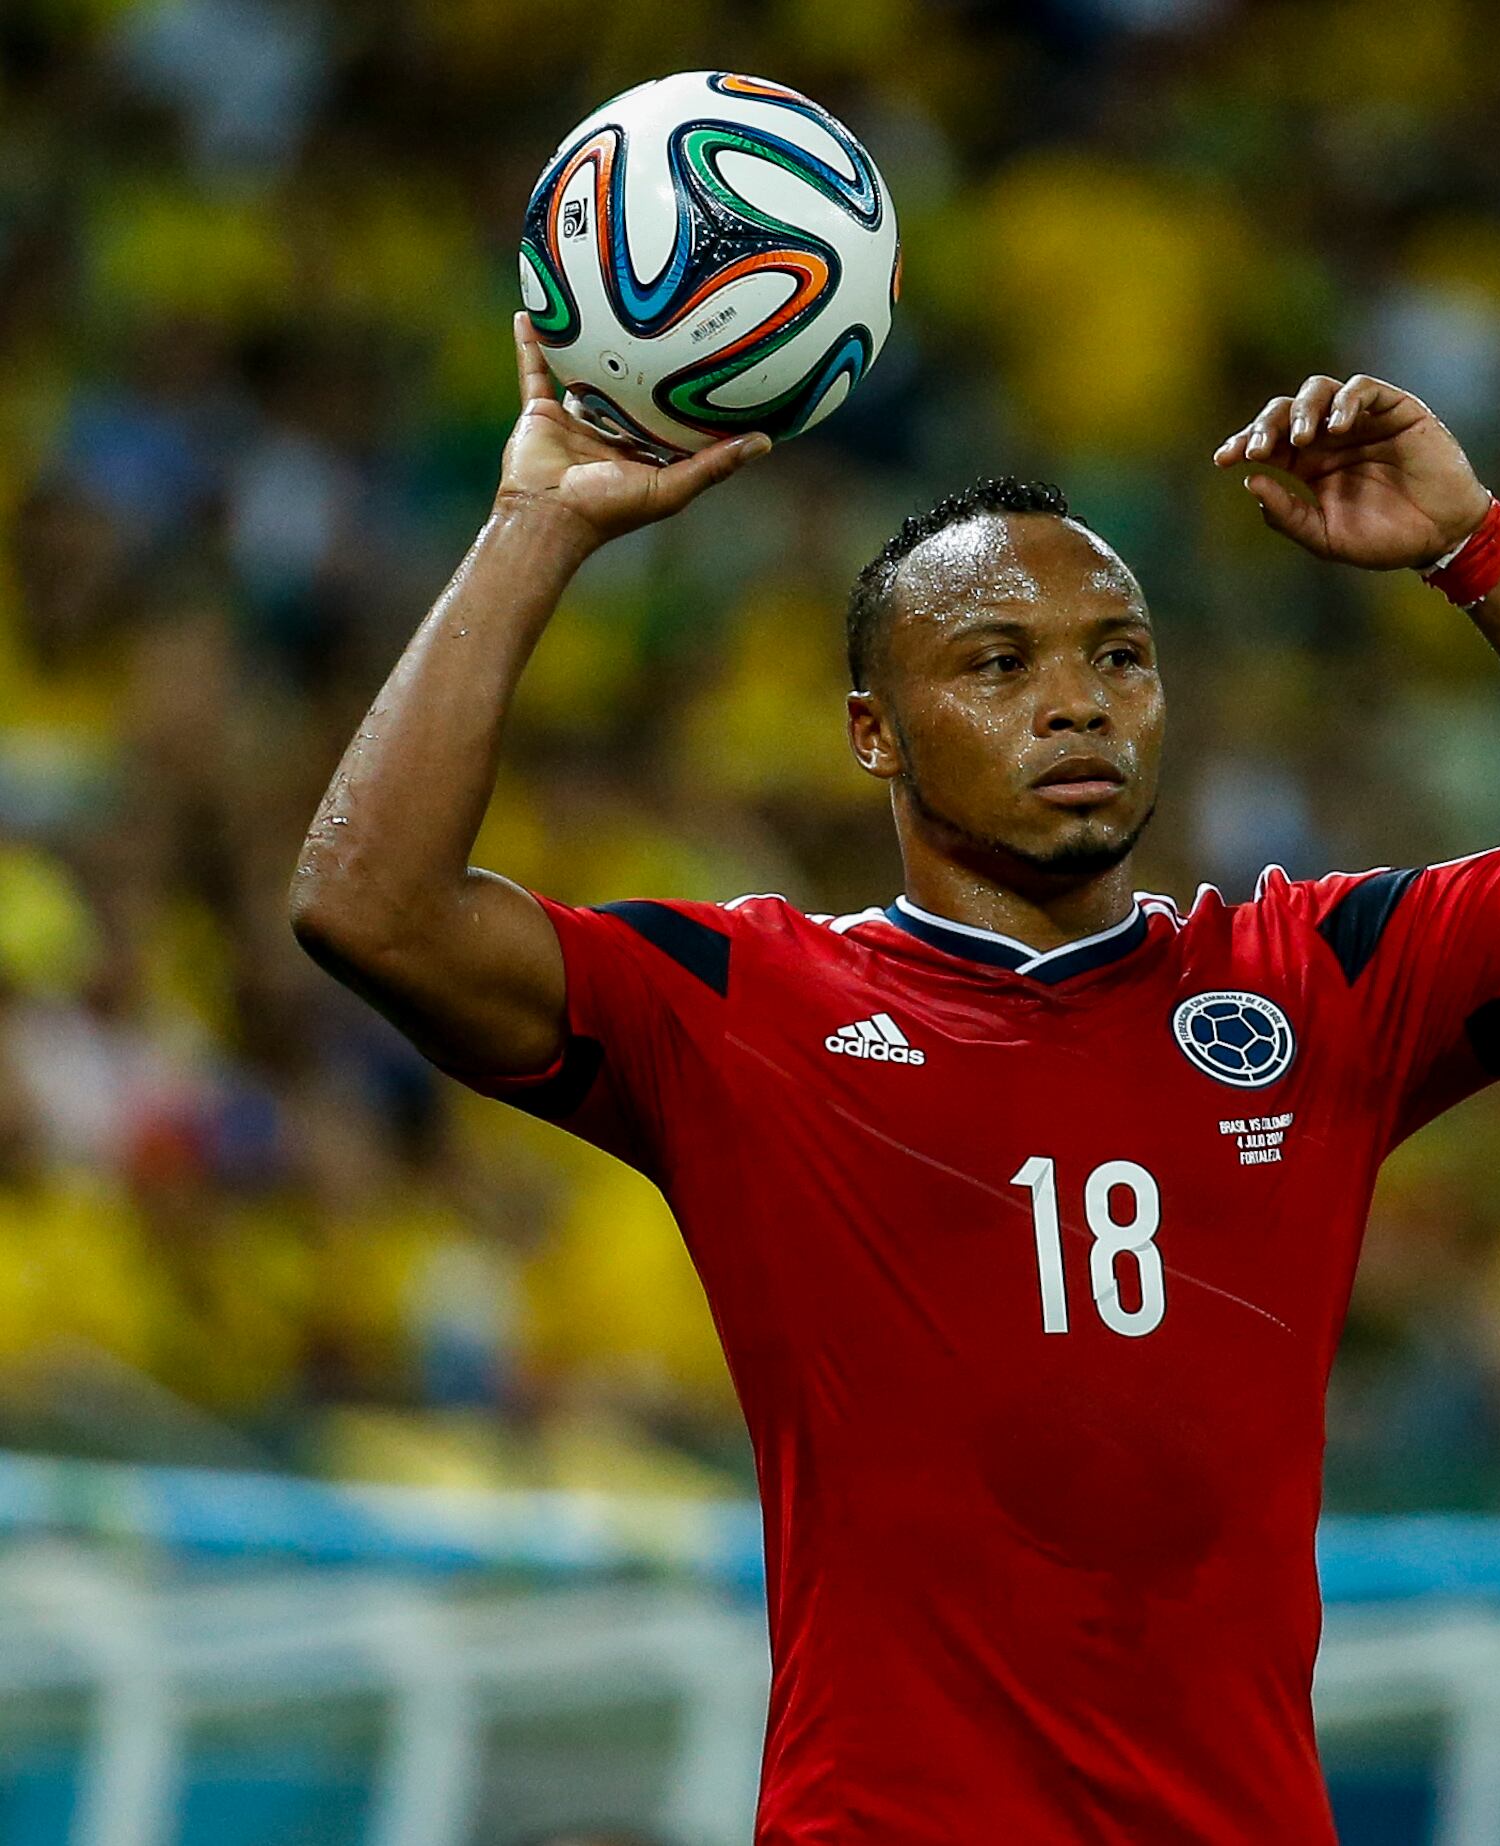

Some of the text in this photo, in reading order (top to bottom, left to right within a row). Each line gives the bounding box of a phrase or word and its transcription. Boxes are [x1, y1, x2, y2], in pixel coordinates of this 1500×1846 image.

[825, 1035, 925, 1066] adidas
[1219, 1120, 1249, 1134] BRASIL
[1237, 1135, 1243, 1149] 4
[1009, 1156, 1166, 1338] 18
